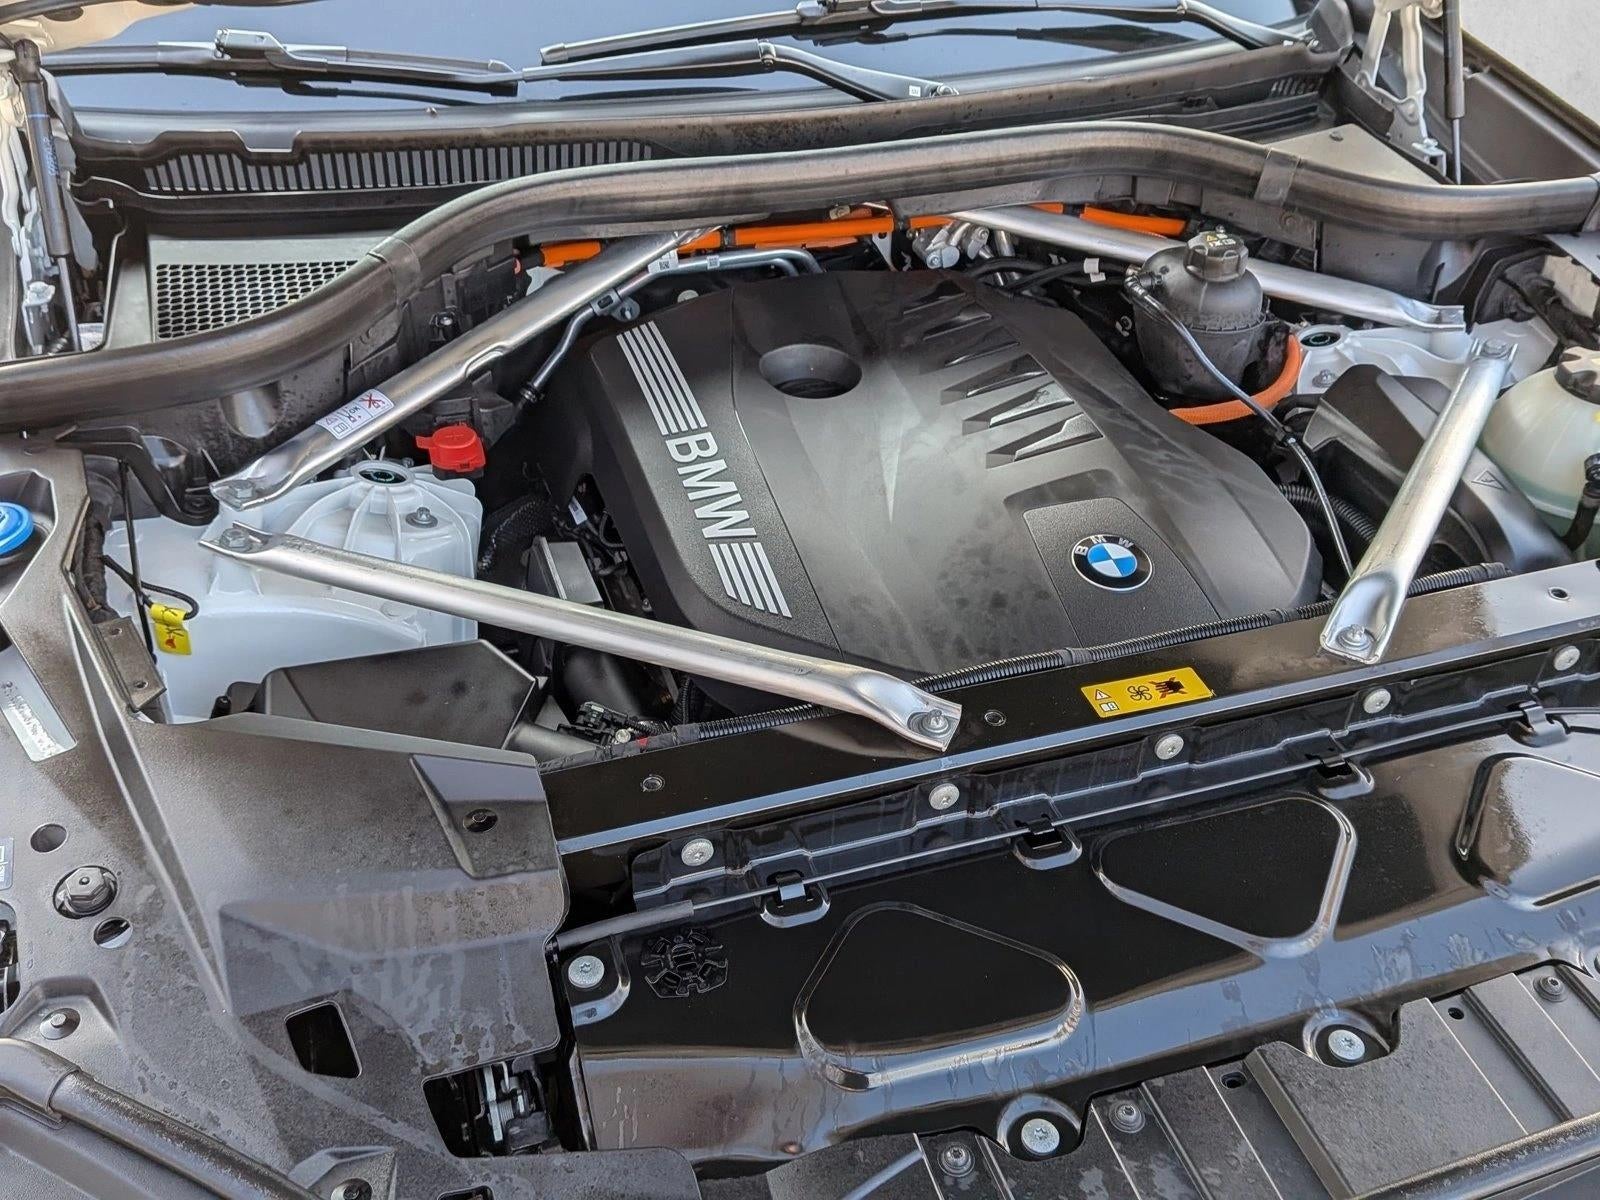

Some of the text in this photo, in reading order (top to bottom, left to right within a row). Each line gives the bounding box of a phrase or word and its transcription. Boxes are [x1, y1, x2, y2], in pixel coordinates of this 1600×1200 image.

[349, 406, 361, 414] OK
[665, 431, 757, 538] BMW
[1075, 535, 1134, 556] BMW
